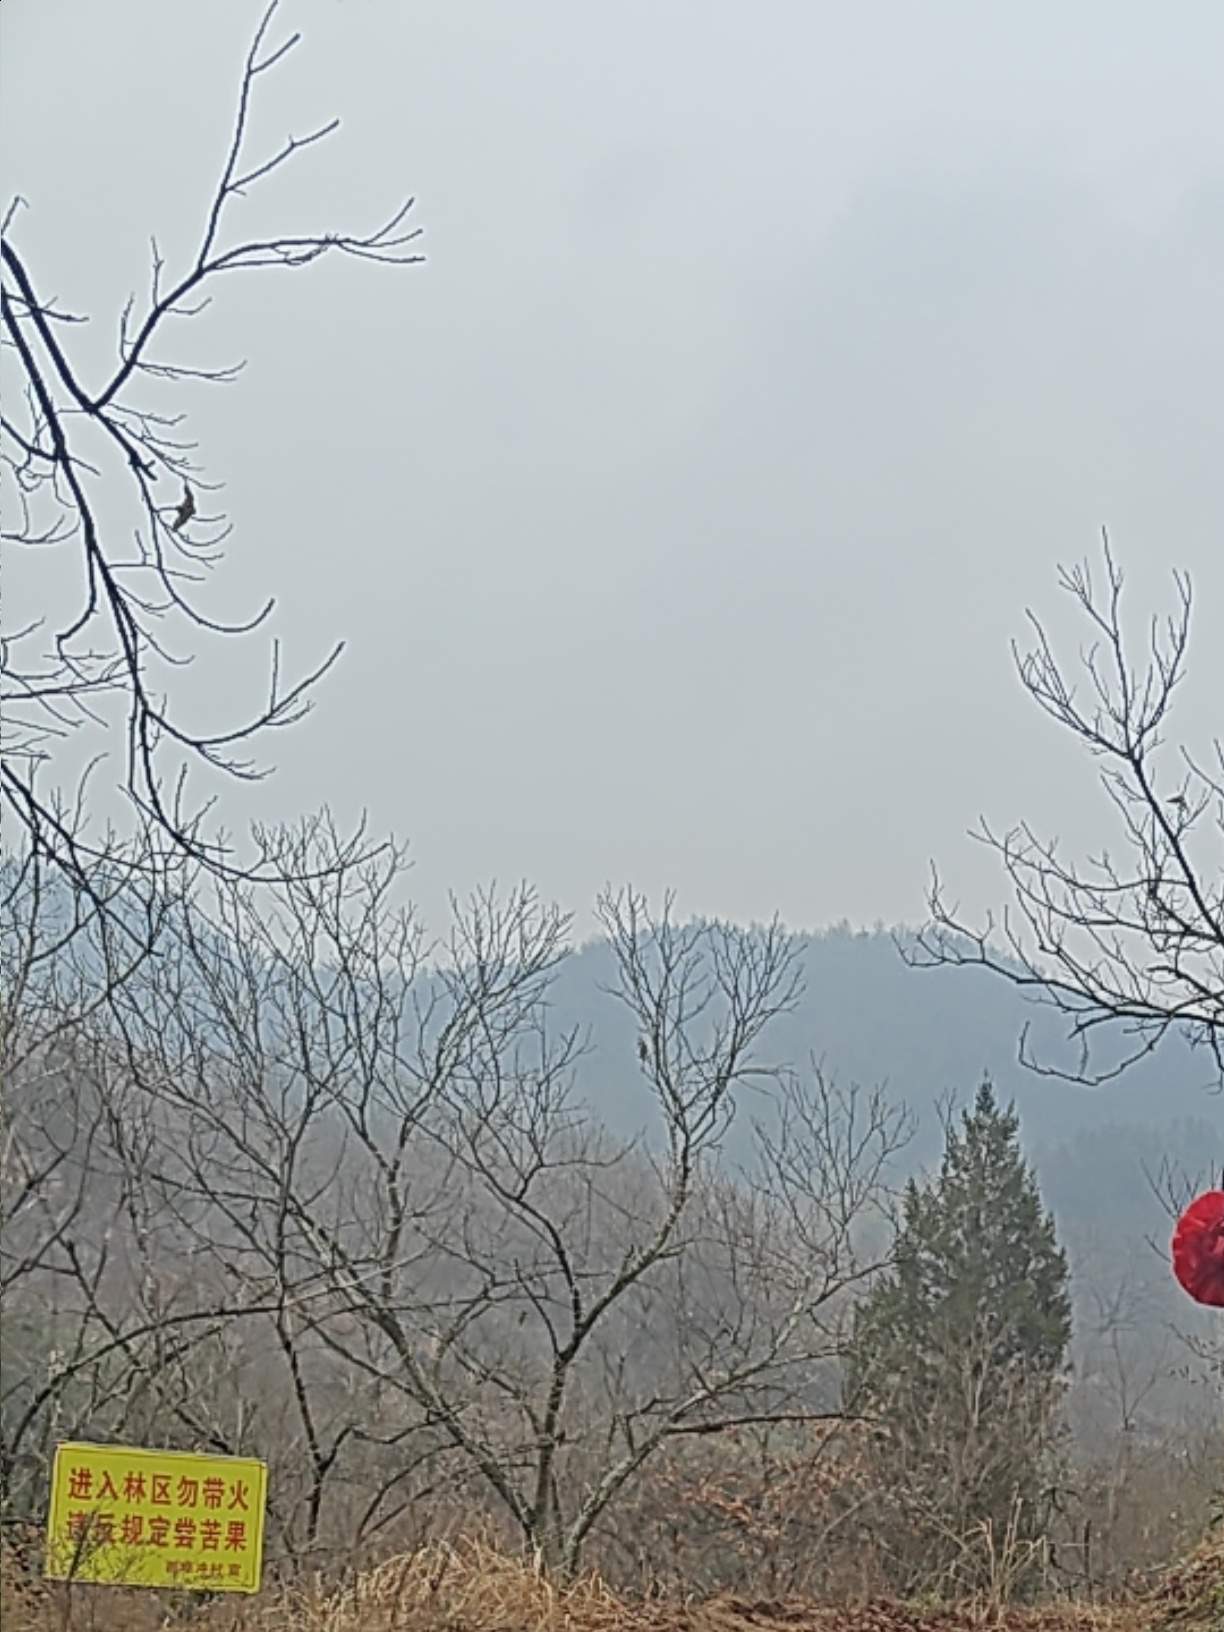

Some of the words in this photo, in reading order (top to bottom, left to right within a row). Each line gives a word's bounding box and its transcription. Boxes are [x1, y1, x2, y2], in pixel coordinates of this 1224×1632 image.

[68, 1467, 249, 1511] 进入林区勿带火
